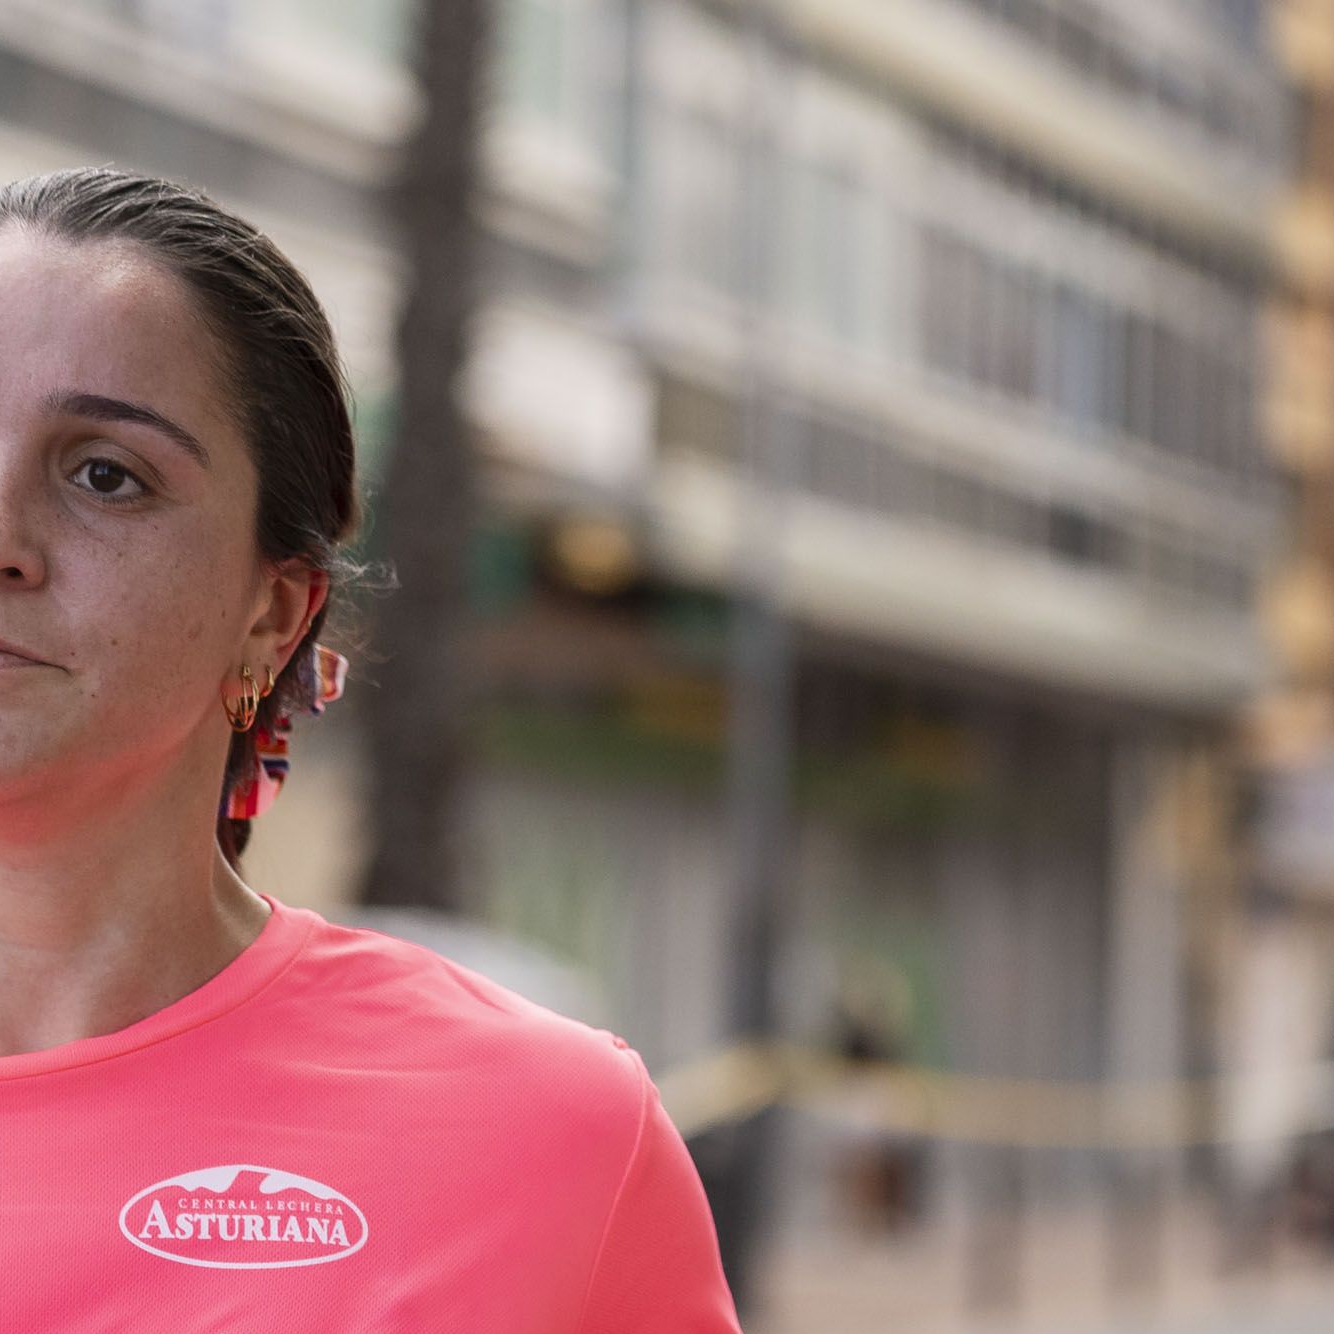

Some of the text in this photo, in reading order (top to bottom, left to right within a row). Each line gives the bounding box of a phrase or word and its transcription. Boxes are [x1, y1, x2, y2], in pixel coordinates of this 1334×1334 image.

[138, 1199, 351, 1247] ASTURIANA
[177, 1198, 344, 1216] CENTRAL LECHERA
